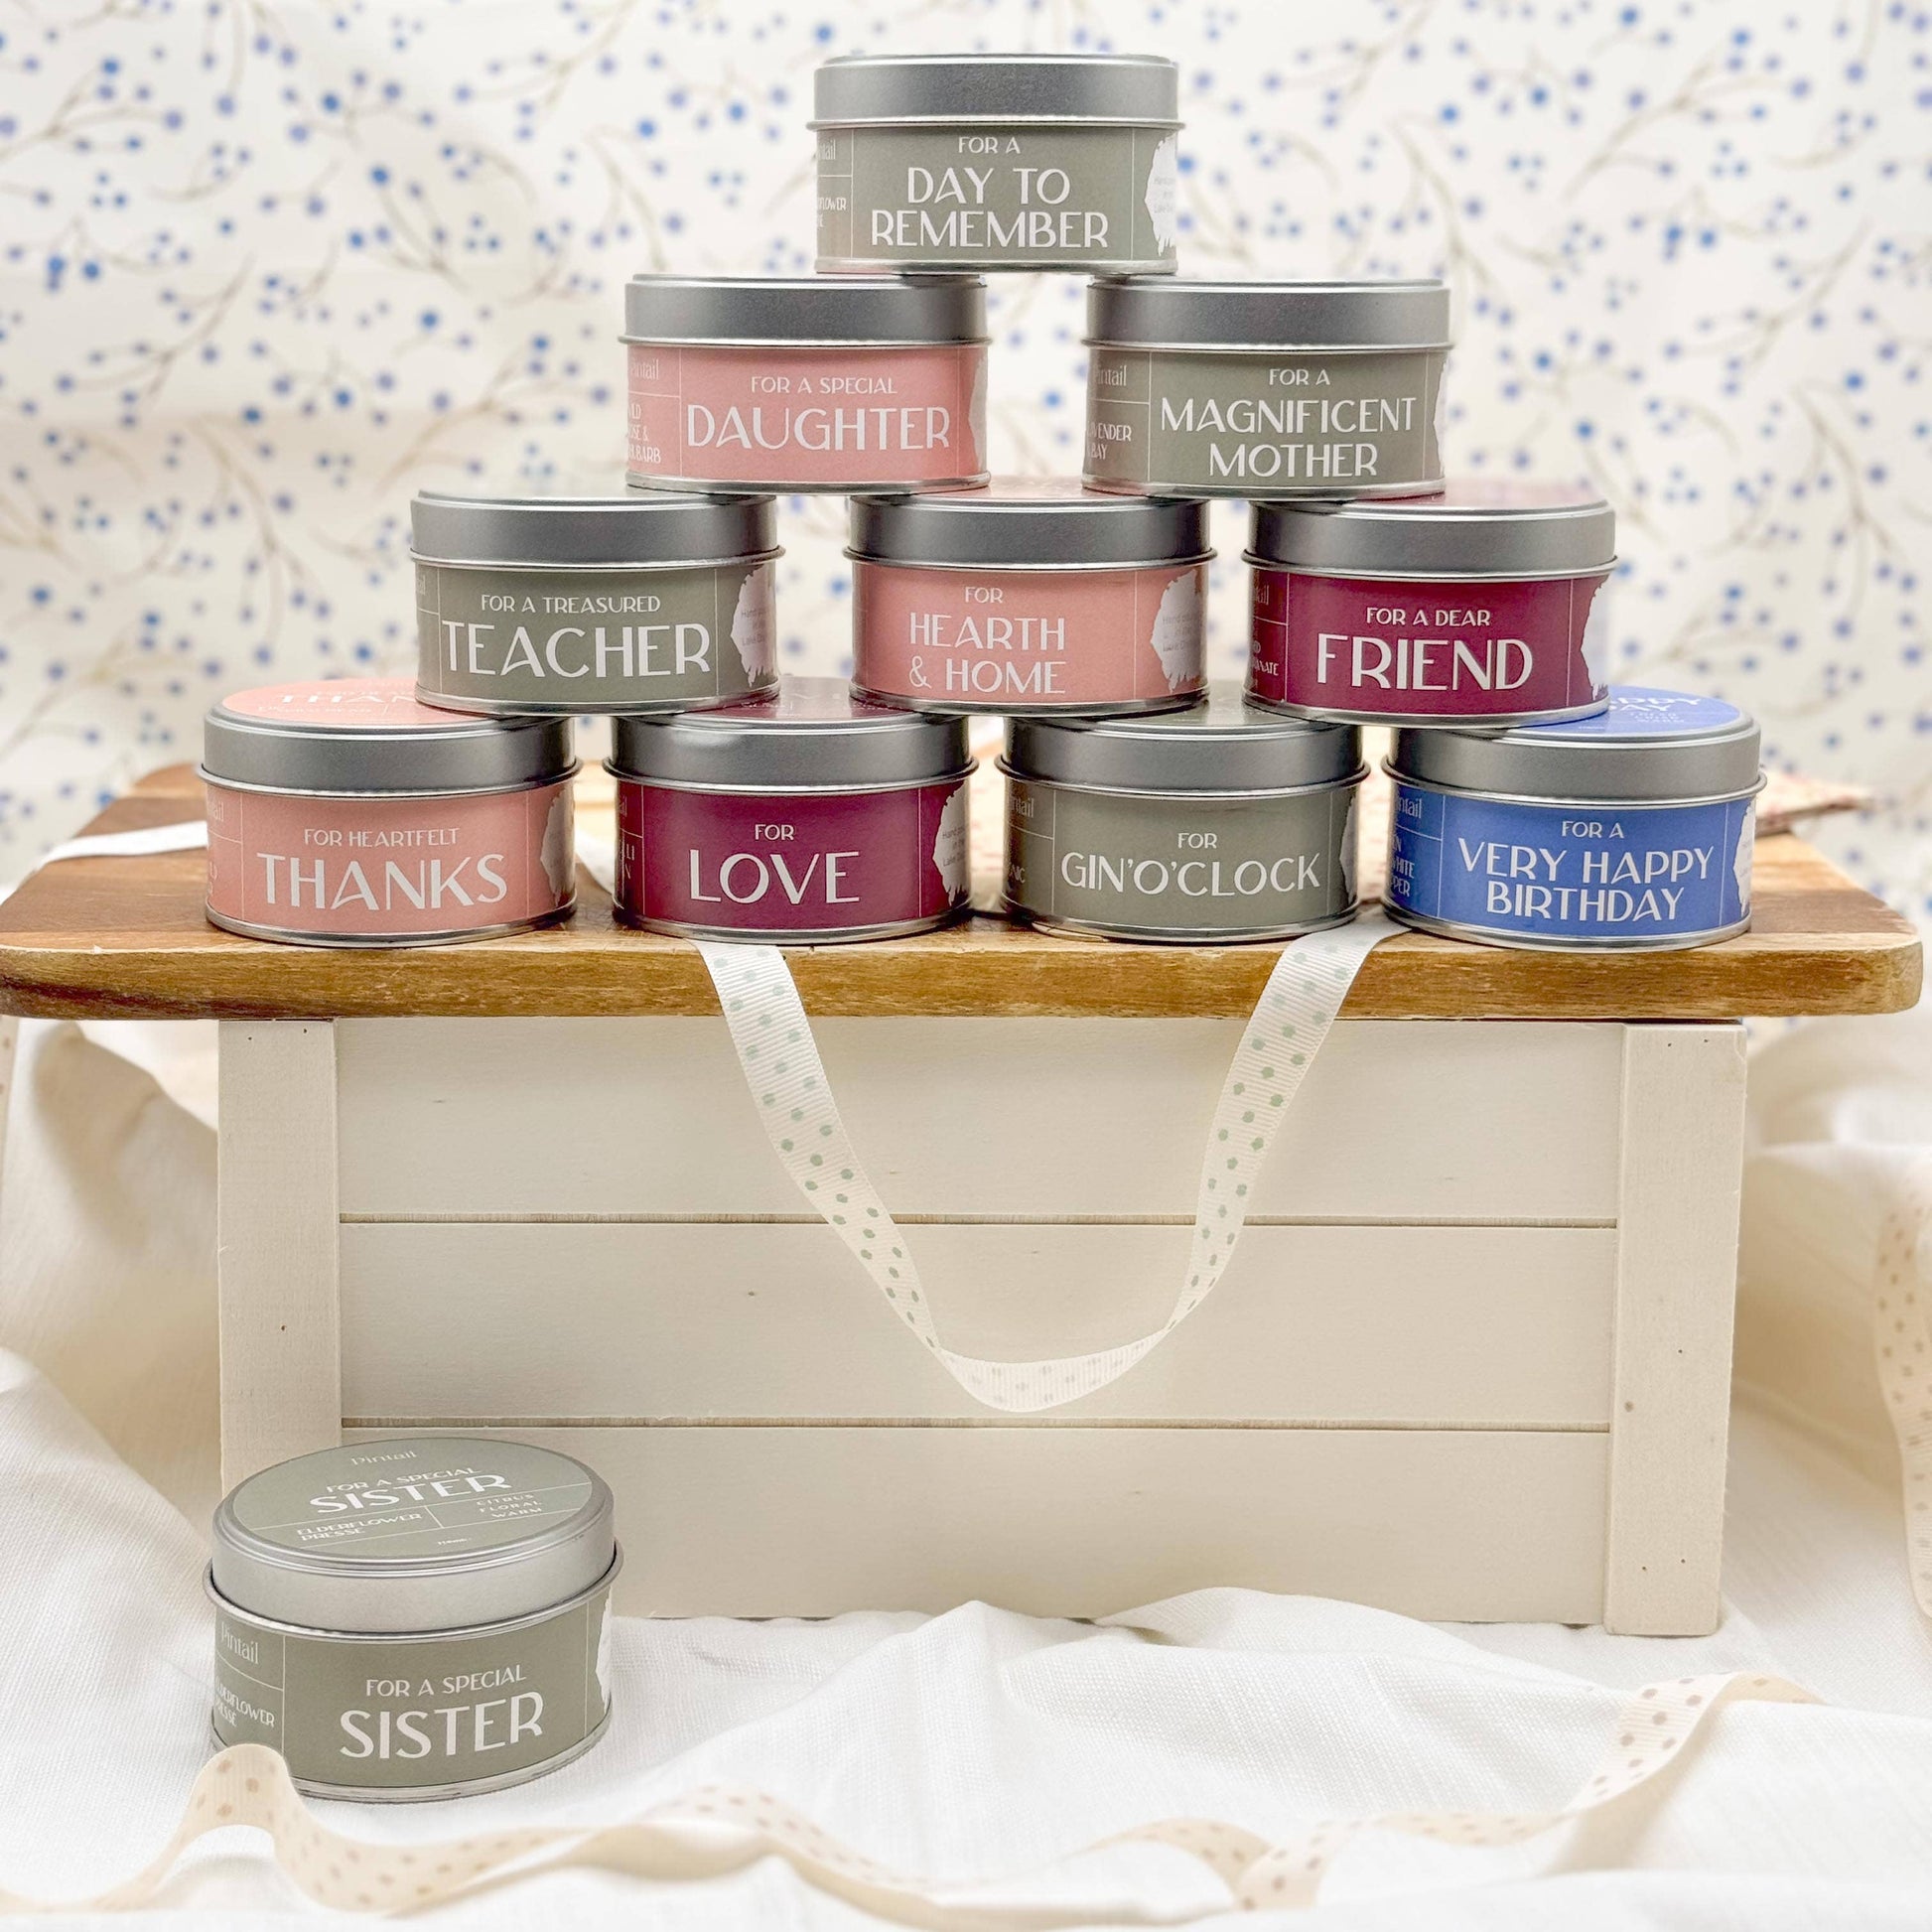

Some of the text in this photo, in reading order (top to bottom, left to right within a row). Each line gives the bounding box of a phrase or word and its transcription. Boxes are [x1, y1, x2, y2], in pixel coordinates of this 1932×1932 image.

[958, 136, 1021, 154] FOR A
[906, 167, 1070, 205] DAY TO
[871, 209, 1109, 248] REMEMBER
[751, 376, 897, 395] FOR A SPECIAL
[1269, 368, 1330, 386] FOR A
[687, 404, 950, 451] DAUGHTER
[1161, 397, 1417, 434] MAGNIFICENT
[1209, 443, 1378, 477] MOTHER
[482, 594, 661, 614] FOR A TREASURED
[965, 586, 1004, 604] FOR
[909, 612, 1065, 650] HEARTH
[1366, 607, 1490, 626] FOR A DEAR
[442, 620, 711, 678] TEACHER
[1316, 632, 1534, 691] FRIEND
[908, 655, 1066, 694] & HOME
[304, 827, 461, 848] FOR HEARTFELT
[755, 823, 795, 841] FOR
[1177, 832, 1217, 850] FOR
[1562, 820, 1624, 840] FOR A
[689, 849, 861, 905] LOVE
[1458, 838, 1715, 886] VERY HAPPY
[256, 852, 508, 911] THANKS
[1486, 881, 1685, 923] BIRTHDAY
[350, 1449, 417, 1465] Pintail
[310, 1474, 513, 1514] SISTER
[326, 1466, 483, 1493] FOR A SPECIAL
[297, 1512, 422, 1536] ELDERFLOWER
[300, 1527, 366, 1542] PRESSE
[366, 1664, 527, 1698] FOR A SPECIAL
[340, 1691, 545, 1759] SISTER
